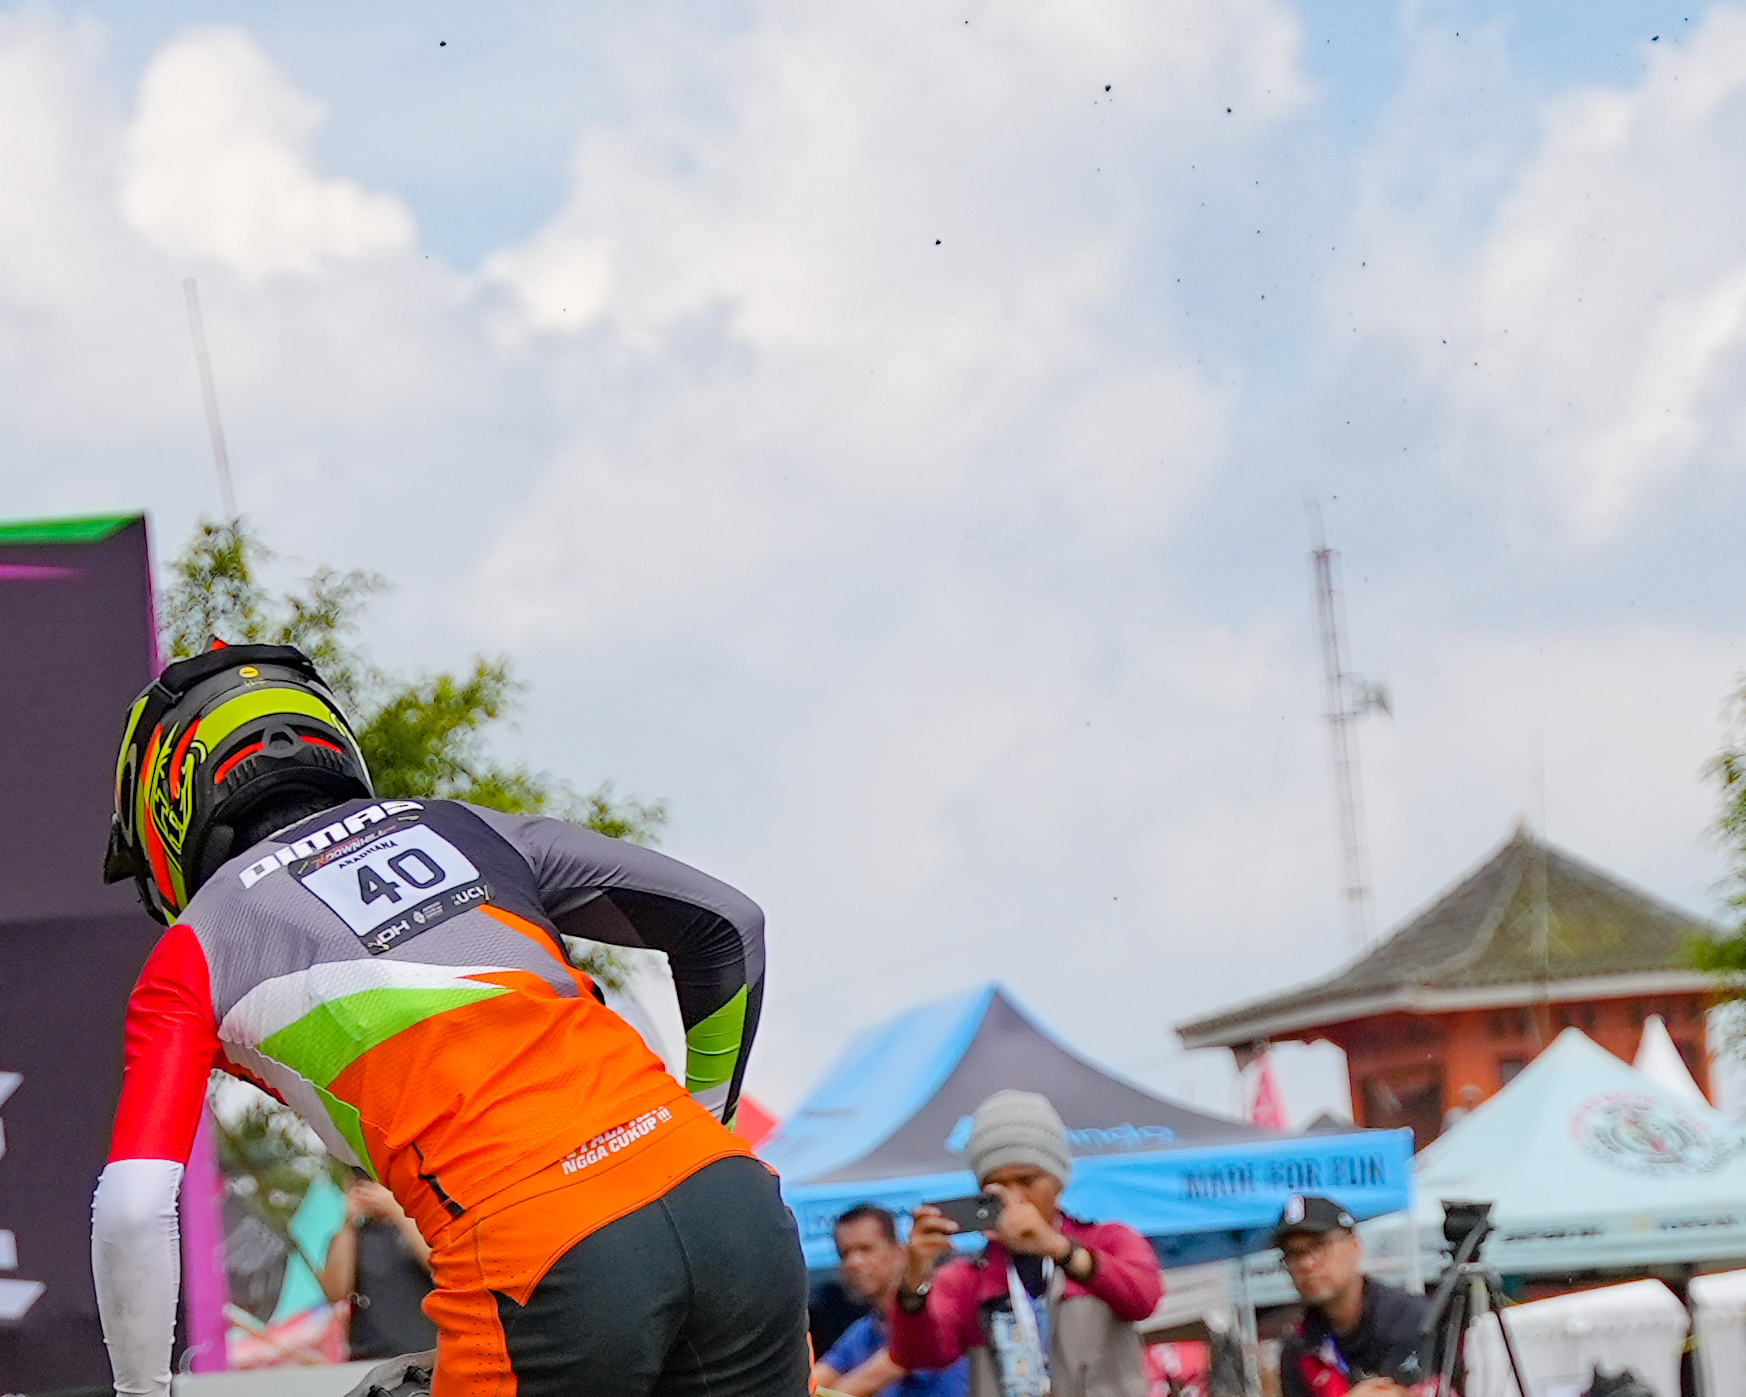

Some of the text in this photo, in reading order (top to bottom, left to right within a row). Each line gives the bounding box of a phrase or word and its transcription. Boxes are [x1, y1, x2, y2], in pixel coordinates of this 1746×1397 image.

[357, 848, 446, 906] 40
[560, 1144, 609, 1175] NGGA
[608, 1116, 658, 1152] CUKUP
